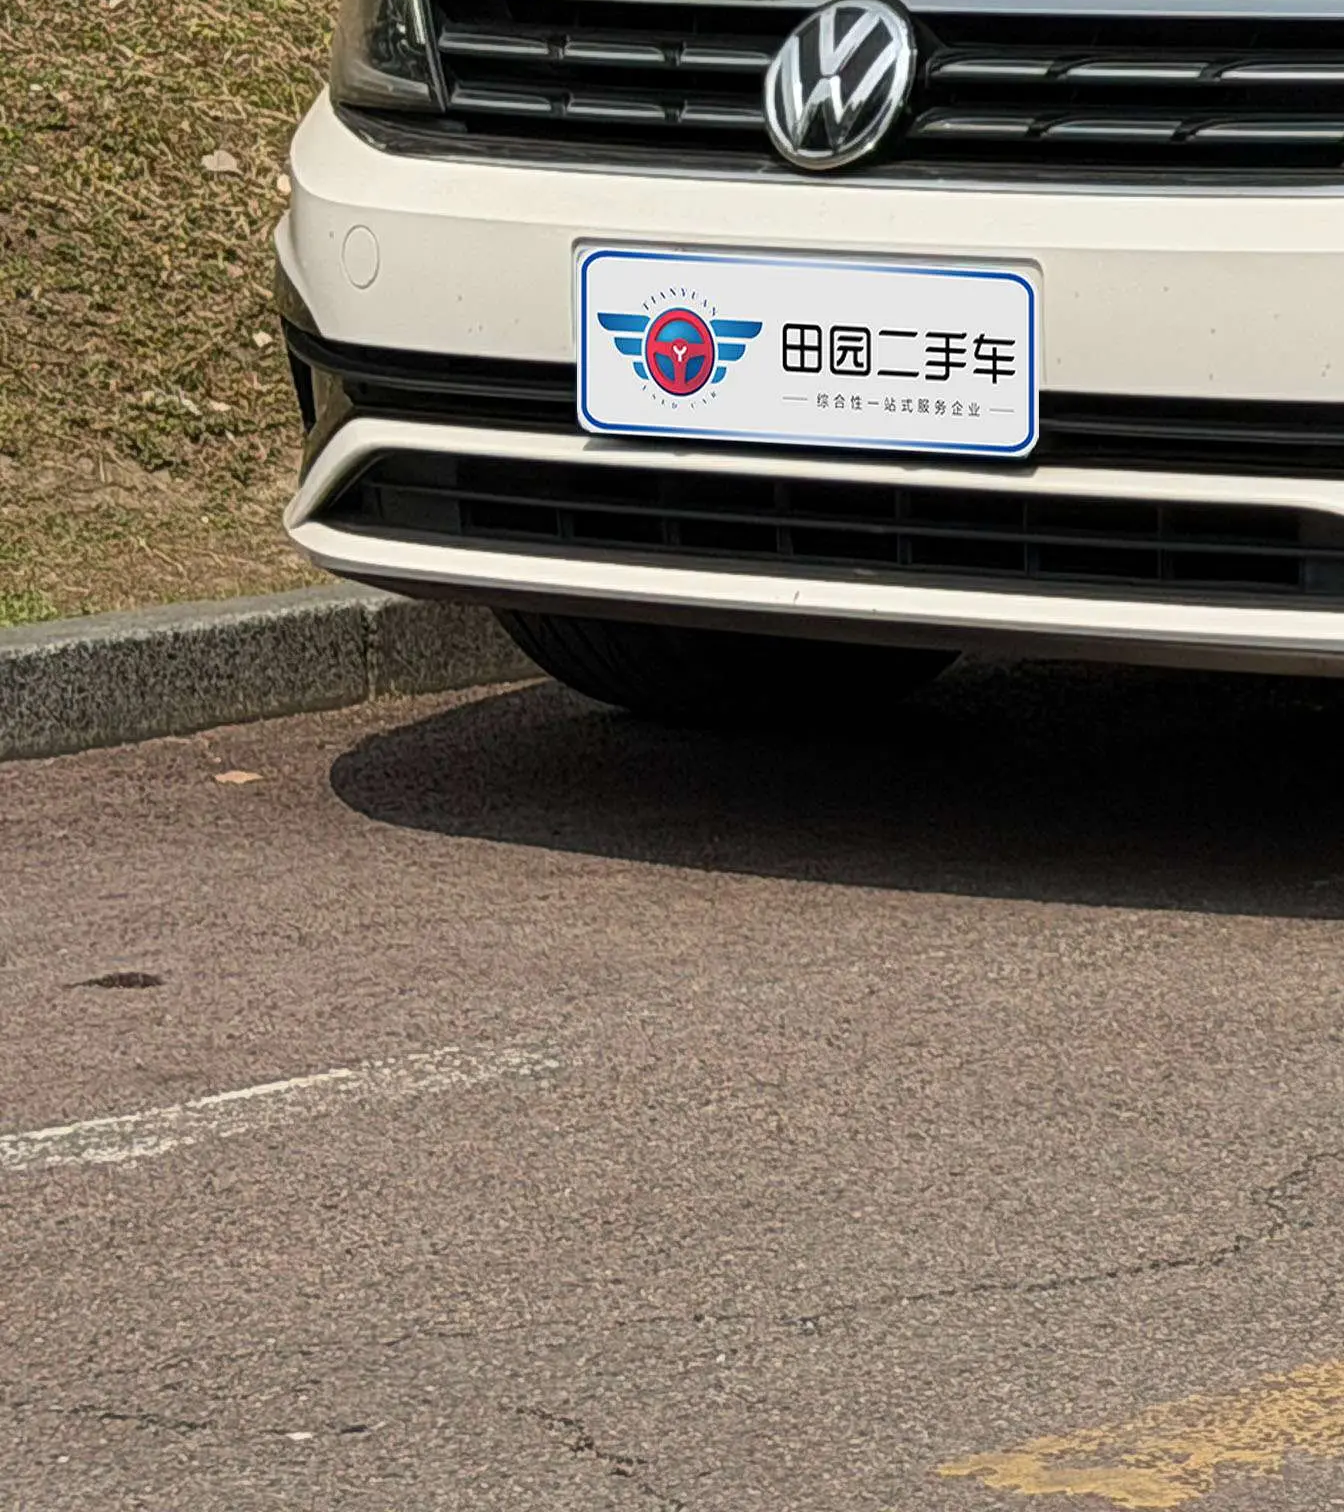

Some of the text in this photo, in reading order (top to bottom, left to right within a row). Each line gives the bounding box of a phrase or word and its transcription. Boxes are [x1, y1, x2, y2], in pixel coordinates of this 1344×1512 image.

[782, 323, 1016, 384] 田园二手车
[816, 392, 981, 418] 综合性一站式服务企业
